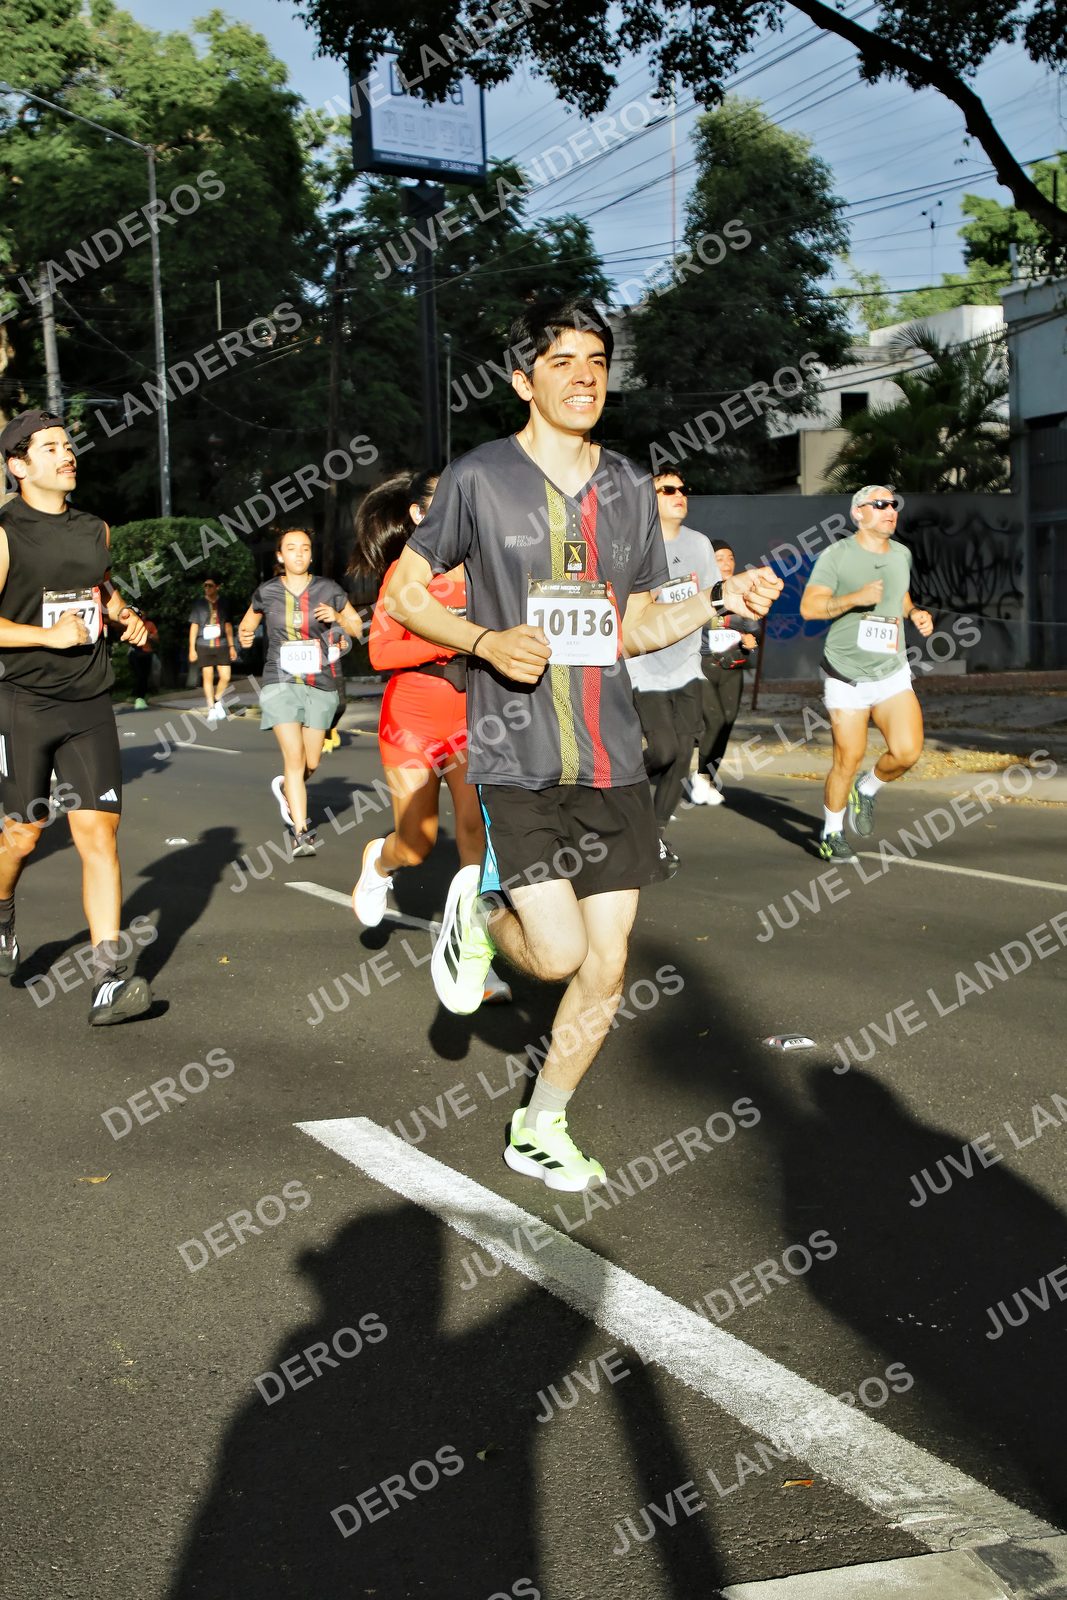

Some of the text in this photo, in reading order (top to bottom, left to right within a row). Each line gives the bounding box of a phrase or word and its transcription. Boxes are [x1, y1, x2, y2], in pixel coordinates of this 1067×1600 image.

[670, 587, 693, 602] 9656
[48, 606, 95, 626] 177
[533, 609, 613, 637] 10136
[866, 626, 893, 640] 8181
